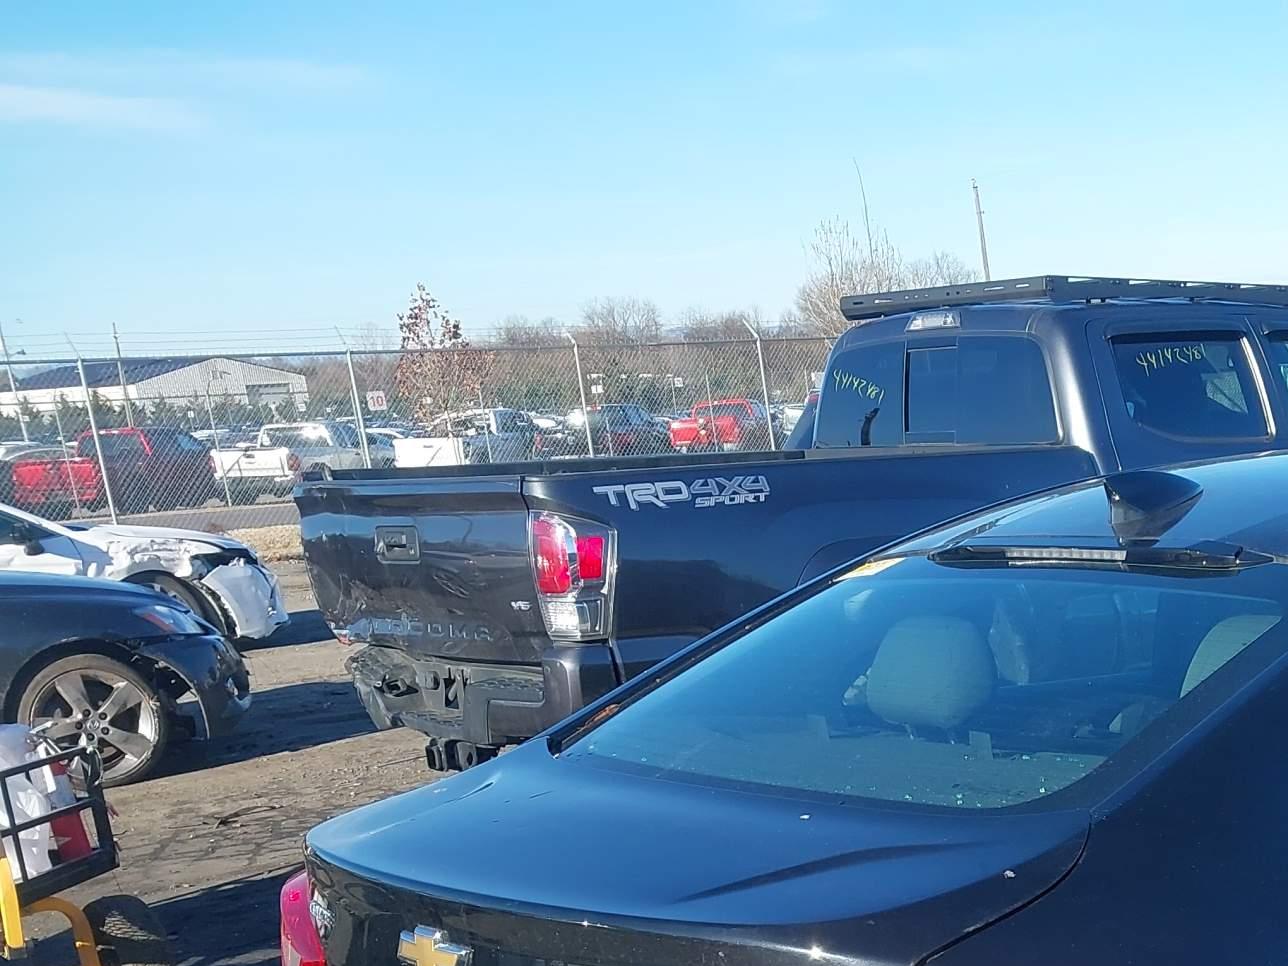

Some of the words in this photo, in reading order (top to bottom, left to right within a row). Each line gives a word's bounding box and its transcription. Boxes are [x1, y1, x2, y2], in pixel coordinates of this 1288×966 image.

[1136, 343, 1206, 376] 44142481
[833, 369, 885, 405] 44142481
[592, 480, 692, 511] TRD
[695, 492, 769, 508] SPORT
